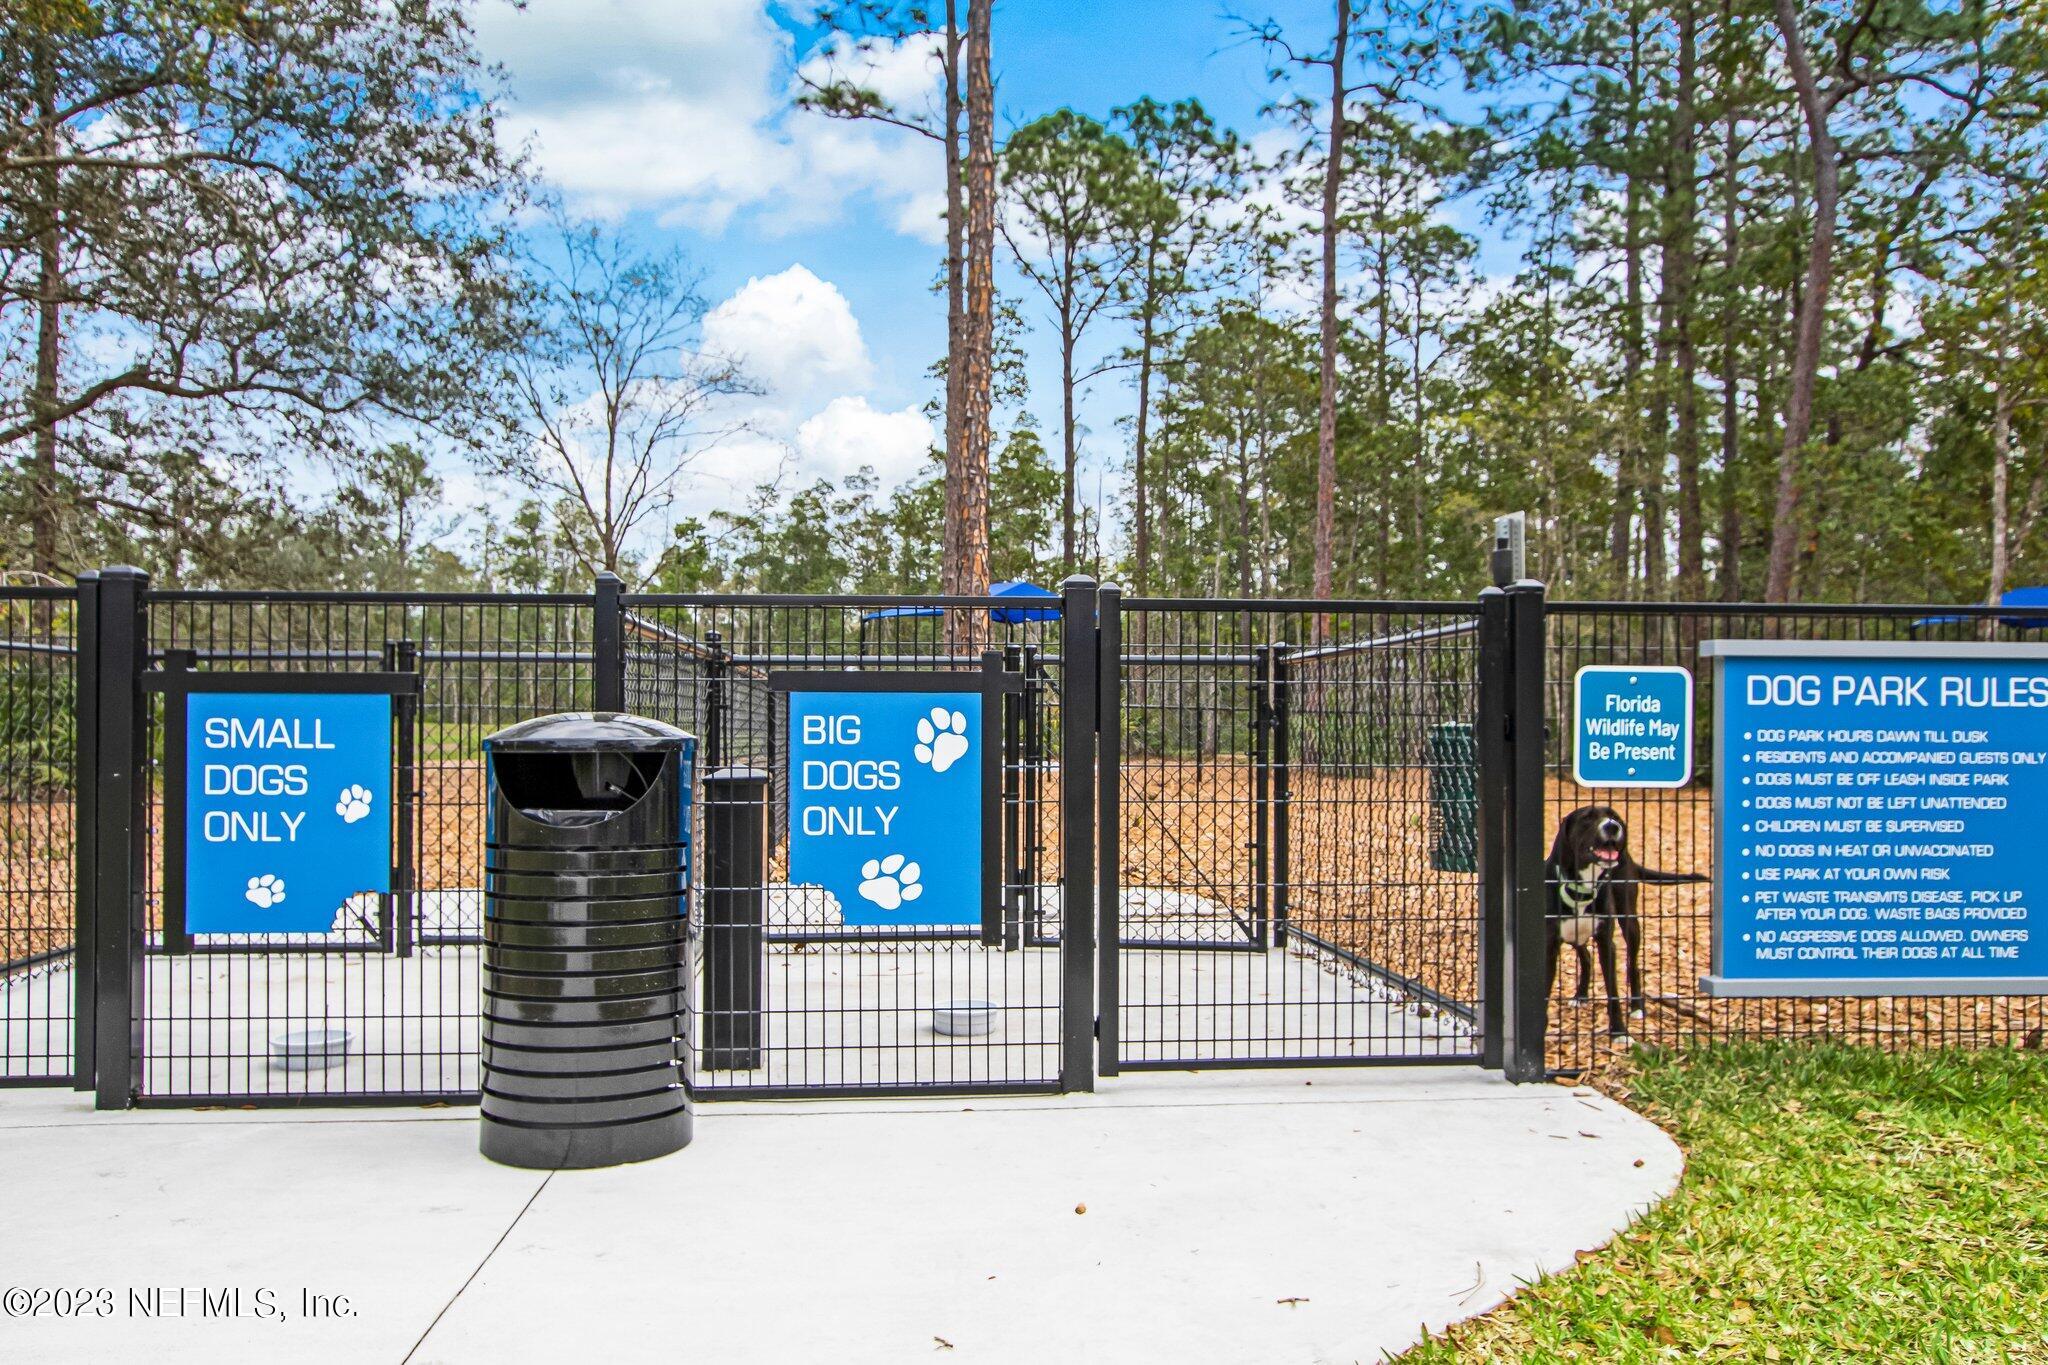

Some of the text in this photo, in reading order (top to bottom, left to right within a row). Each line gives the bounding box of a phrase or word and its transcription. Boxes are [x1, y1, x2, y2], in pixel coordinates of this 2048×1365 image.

[1747, 674, 2048, 708] DOG PARK RULES
[1605, 693, 1661, 713] Florida
[204, 717, 336, 750] SMALL
[803, 714, 861, 745] BIG
[1585, 717, 1680, 741] Wildlife May
[1756, 729, 1989, 744] DOG PARK HOURS DAWN TILL DUSK
[1589, 741, 1676, 761] Be Present
[1755, 750, 2047, 765] RESIDENTS AND ACCOMPANIED GUESTS ONLY
[204, 764, 309, 796] DOGS
[802, 760, 901, 791] DOGS
[1755, 772, 2009, 787] DOGS MUST BE OFF LEASH INSIDE PARK
[1755, 796, 2008, 810] DOGS MUST NOT BE LEFT UNATTENDED
[204, 810, 306, 843] ONLY
[802, 805, 899, 836] ONLY
[1755, 819, 1965, 833] CHILDREN MUST BE SUPERVISED
[1755, 844, 1994, 858] NO DOGS IN HEAT OR UNVACCINATED
[1754, 867, 1950, 881] USE PARK AT YOUR OWN RISK
[1754, 890, 1780, 904] PET
[1782, 890, 1830, 904] WASTE
[1833, 890, 1909, 904] TRANSMITS
[1971, 890, 2000, 904] PICK
[2003, 890, 2023, 903] UP
[1755, 907, 1797, 921] AFTER
[1799, 907, 1836, 921] YOUR
[1874, 907, 1922, 920] WASTE
[1924, 907, 1961, 920] BAGS
[1963, 907, 2028, 920] PROVIDED
[1755, 930, 1777, 943] NO
[1779, 930, 1858, 943] AGGRESSIVE
[1860, 929, 1897, 943] DOGS
[1970, 929, 2029, 943] OWNERS
[1755, 946, 2019, 960] MUST CONTROL THEIR DOGS AT ALL TIME
